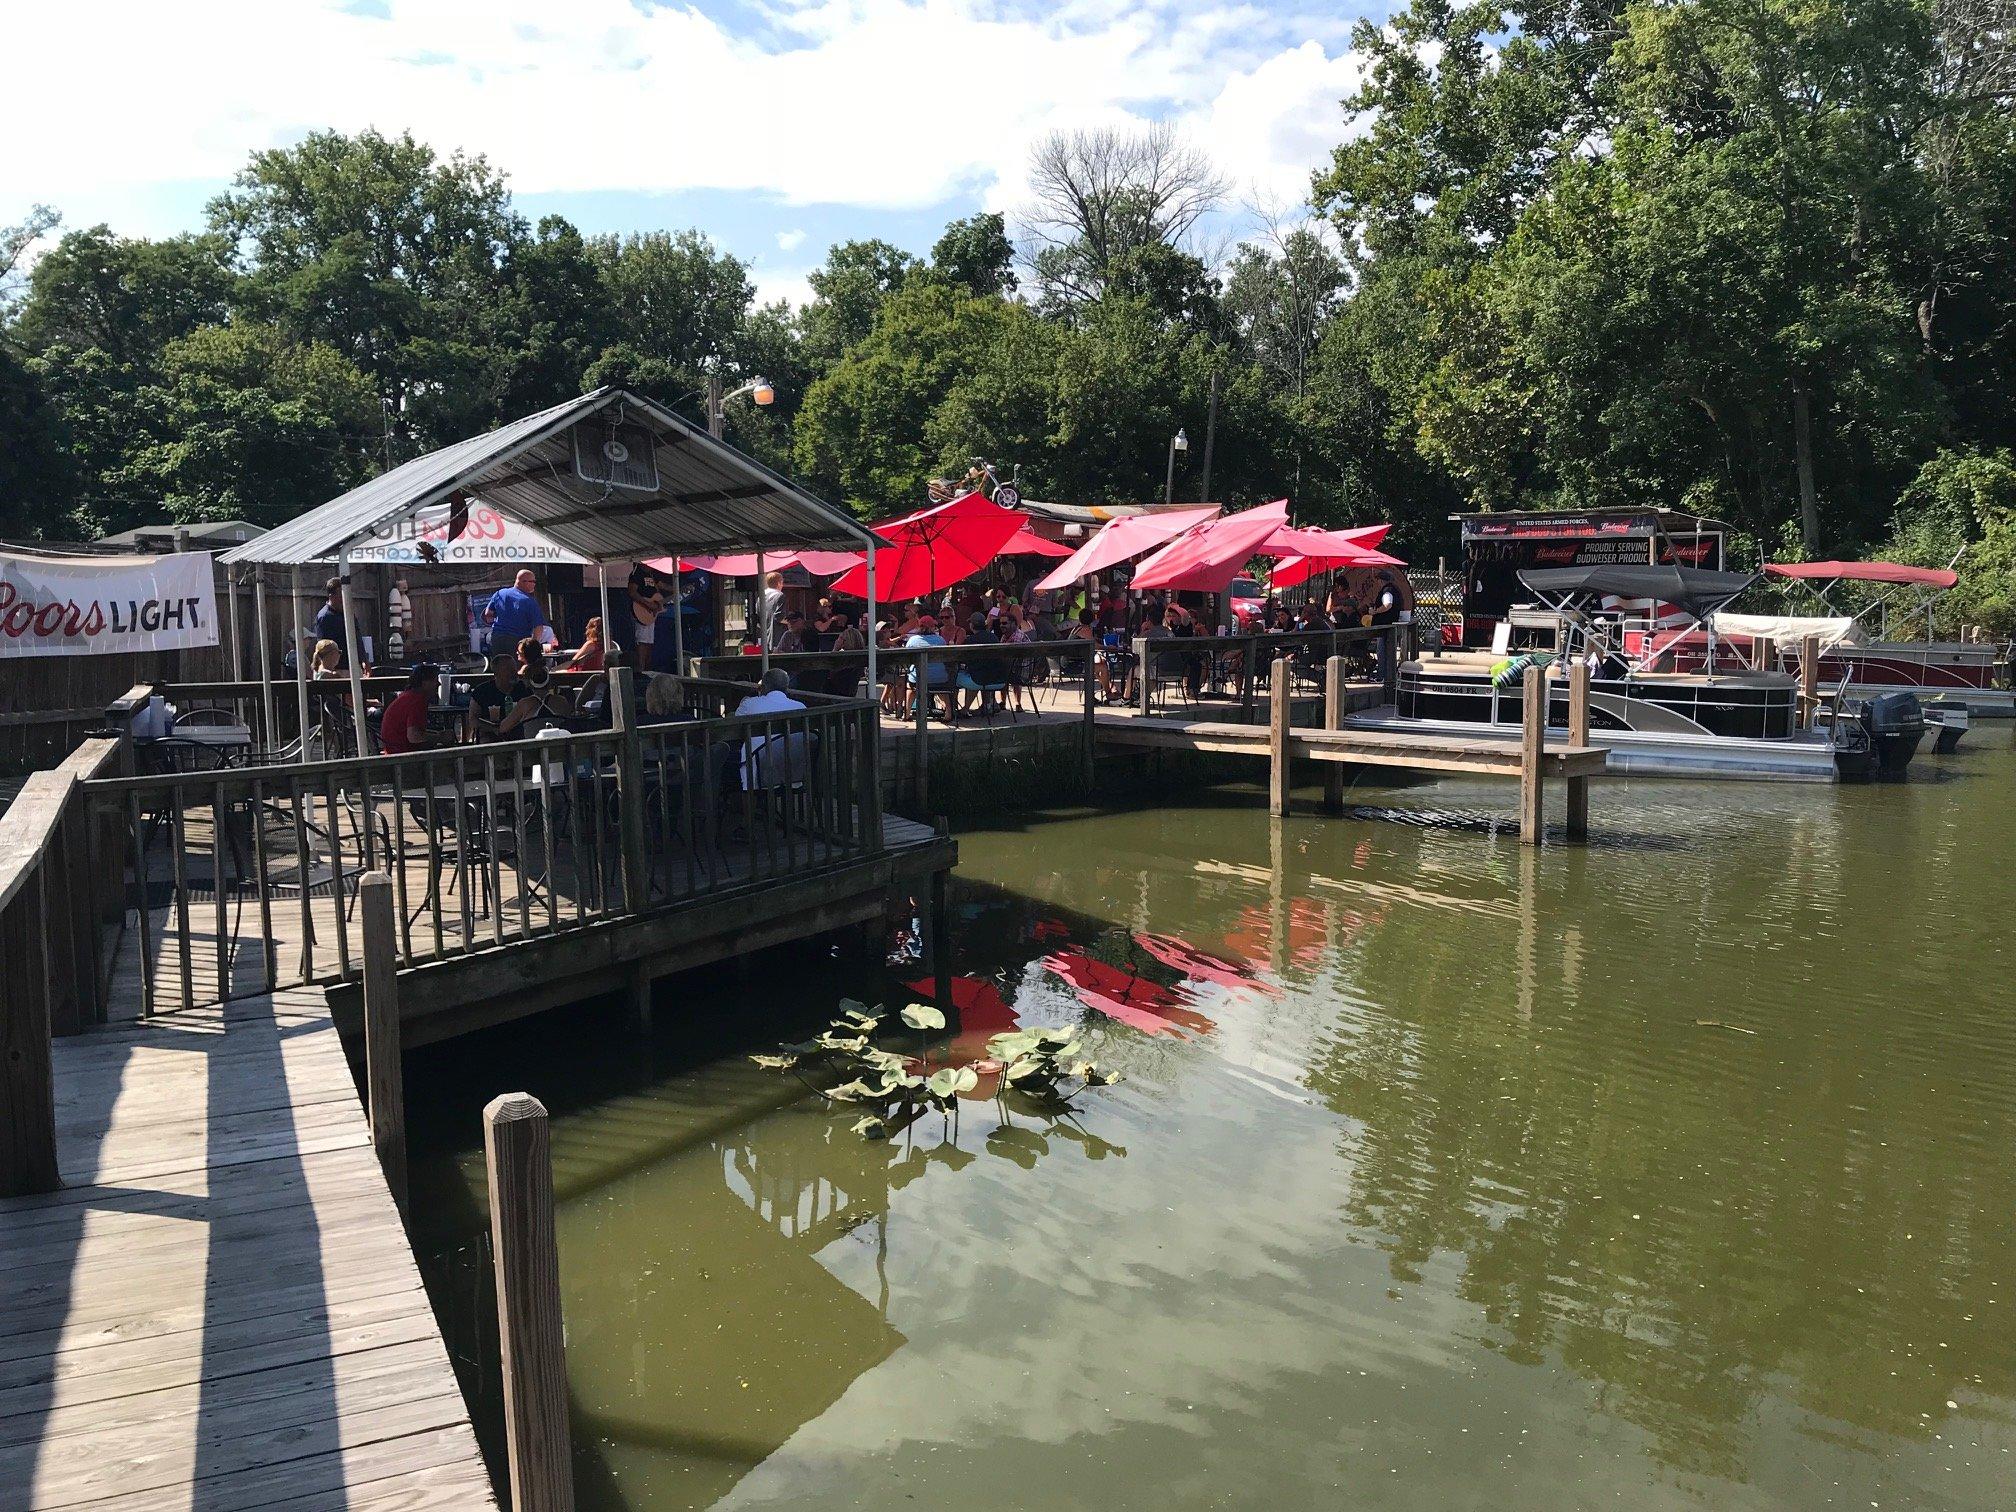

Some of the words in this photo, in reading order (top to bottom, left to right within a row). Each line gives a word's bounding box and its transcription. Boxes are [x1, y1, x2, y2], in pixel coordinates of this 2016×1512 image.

[1585, 542, 1615, 553] PROUDLY
[1617, 541, 1648, 552] SERVING
[1576, 553, 1617, 563] BUDWEISER
[1618, 552, 1650, 563] PRODUC
[109, 597, 200, 634] LIGHT
[1551, 717, 1612, 726] BENTON
